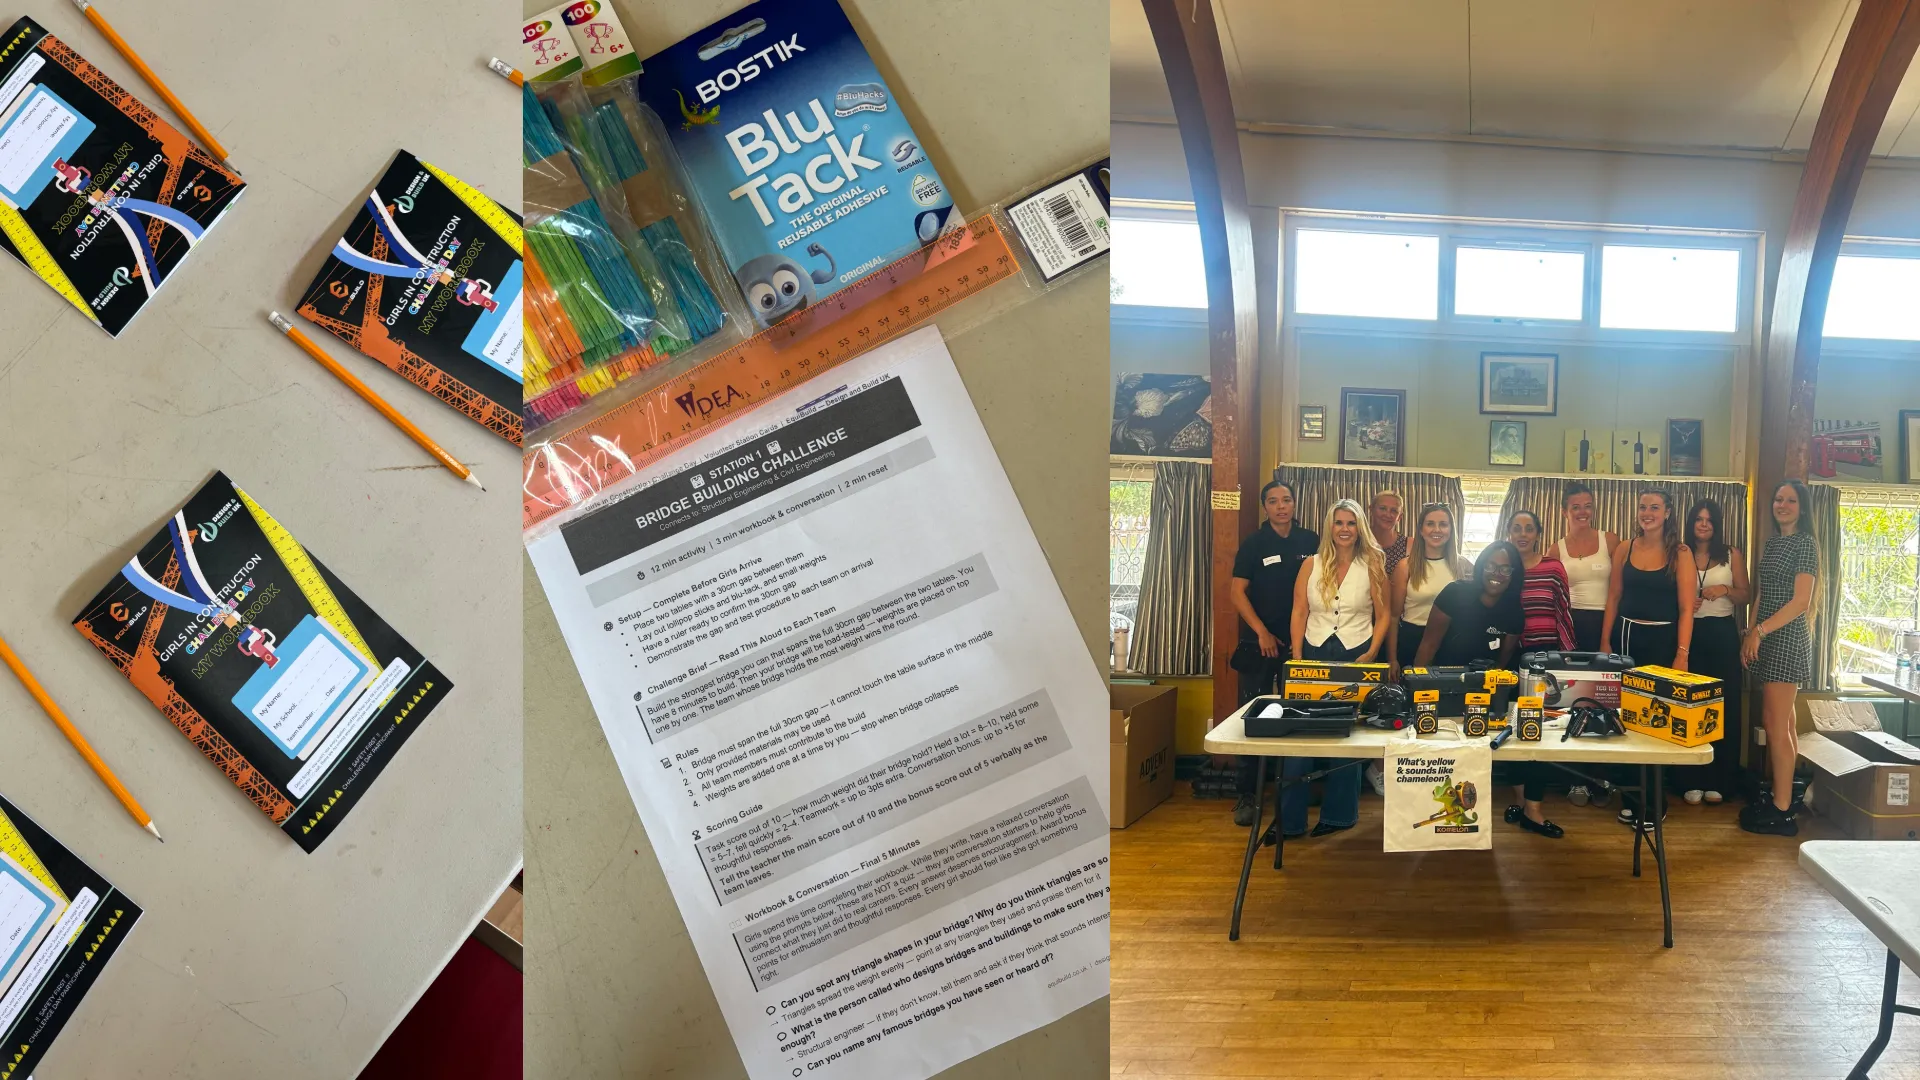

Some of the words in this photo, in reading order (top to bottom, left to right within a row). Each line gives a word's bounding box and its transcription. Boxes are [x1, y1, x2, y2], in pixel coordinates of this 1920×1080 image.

[567, 4, 595, 21] 100
[554, 52, 568, 61] 6+
[610, 43, 624, 53] 6+
[696, 33, 806, 104] BOSTIK
[836, 90, 884, 100] #BluHacks
[725, 99, 834, 176] Blu
[113, 141, 133, 164] MY
[137, 153, 162, 179] GIRLS
[897, 156, 927, 174] REUSABLE
[90, 161, 139, 216] CHALLENGE
[128, 178, 140, 190] IN
[405, 174, 421, 194] DESIGN
[411, 181, 424, 198] BUILD
[421, 173, 430, 182] UK
[729, 133, 881, 226] Tack
[915, 181, 937, 195] SOLVENT
[918, 185, 942, 202] FREE
[51, 162, 117, 234] WORKBOOK
[789, 212, 813, 228] THE
[814, 186, 865, 216] ORIGINAL
[69, 190, 130, 260] CONSTRUCTION
[74, 213, 95, 237] DAY
[777, 214, 834, 249] REUSABLE
[835, 185, 888, 220] ADHESIVE
[384, 296, 408, 325] GIRLS
[403, 285, 415, 297] IN
[409, 215, 461, 285] CONSTRUCTION
[408, 257, 449, 314] CHALLENGE
[442, 236, 461, 259] DAY
[840, 256, 886, 282] ORIGINAL
[98, 281, 113, 298] BUILD
[100, 286, 118, 306] DESIGN
[417, 310, 437, 334] MY
[430, 237, 485, 311] WORKBOOK
[91, 297, 100, 306] UK
[635, 496, 692, 529] BRIDGE
[692, 466, 760, 504] BUILDING
[761, 427, 848, 473] CHALLENGE
[708, 452, 754, 479] STATION
[755, 449, 762, 458] 1
[659, 514, 691, 531] Connects
[691, 509, 701, 517] to:
[701, 494, 733, 512] Structural
[733, 477, 774, 499] Engineering
[779, 466, 795, 478] Civil
[794, 450, 835, 471] Engineering
[211, 502, 232, 522] DESIGN
[216, 510, 233, 527] BUILD
[231, 502, 241, 511] UK
[650, 564, 661, 573] 12
[661, 558, 677, 569] min
[678, 545, 706, 562] activity
[722, 531, 738, 542] min
[738, 514, 777, 535] workbook
[785, 488, 835, 514] conversation
[844, 480, 851, 488] 2
[851, 474, 867, 485] min
[867, 464, 888, 478] reset
[617, 610, 642, 625] Setup
[652, 589, 690, 609] Complete
[690, 577, 718, 592] Before
[718, 567, 738, 580] Girls
[739, 557, 762, 572] Arrive
[160, 632, 187, 661] GIRLS
[184, 621, 198, 634] IN
[196, 553, 261, 622] CONSTRUCTION
[184, 597, 238, 656] CHALLENGE
[234, 577, 255, 601] DAY
[191, 653, 213, 679] MY
[209, 582, 280, 656] WORKBOOK
[1362, 672, 1380, 680] XR
[1672, 686, 1687, 697] XR
[258, 707, 268, 716] My
[272, 720, 282, 729] My
[351, 748, 366, 767] SAFETY
[364, 736, 376, 750] FIRST
[675, 747, 699, 762] Rules
[1140, 747, 1167, 779] ADVENT
[1427, 758, 1455, 767] yellow
[341, 761, 366, 789] CHALLENGE
[363, 751, 373, 763] DAY
[706, 815, 738, 833] Scoring
[738, 804, 763, 818] Guide
[744, 898, 787, 922] Workbook
[787, 894, 795, 903] &
[795, 871, 849, 899] Conversation
[859, 855, 881, 870] Final
[881, 852, 888, 860] 5
[887, 839, 920, 858] Minutes
[9, 926, 22, 940] Date:
[38, 994, 55, 1016] SAFETY
[53, 978, 66, 995] FIRST
[807, 1059, 825, 1070] Can
[824, 1051, 841, 1064] you
[842, 1040, 865, 1055] name
[866, 1032, 881, 1044] any
[881, 1018, 913, 1036] famous
[913, 1003, 946, 1022] bridges
[946, 996, 962, 1010] you
[962, 986, 983, 1000] have
[984, 976, 1004, 990] seen
[1005, 971, 1014, 980] or
[1014, 959, 1040, 975] heard
[1040, 952, 1054, 964] of?
[28, 1008, 54, 1043] CHALLENGE
[51, 996, 62, 1009] DAY
